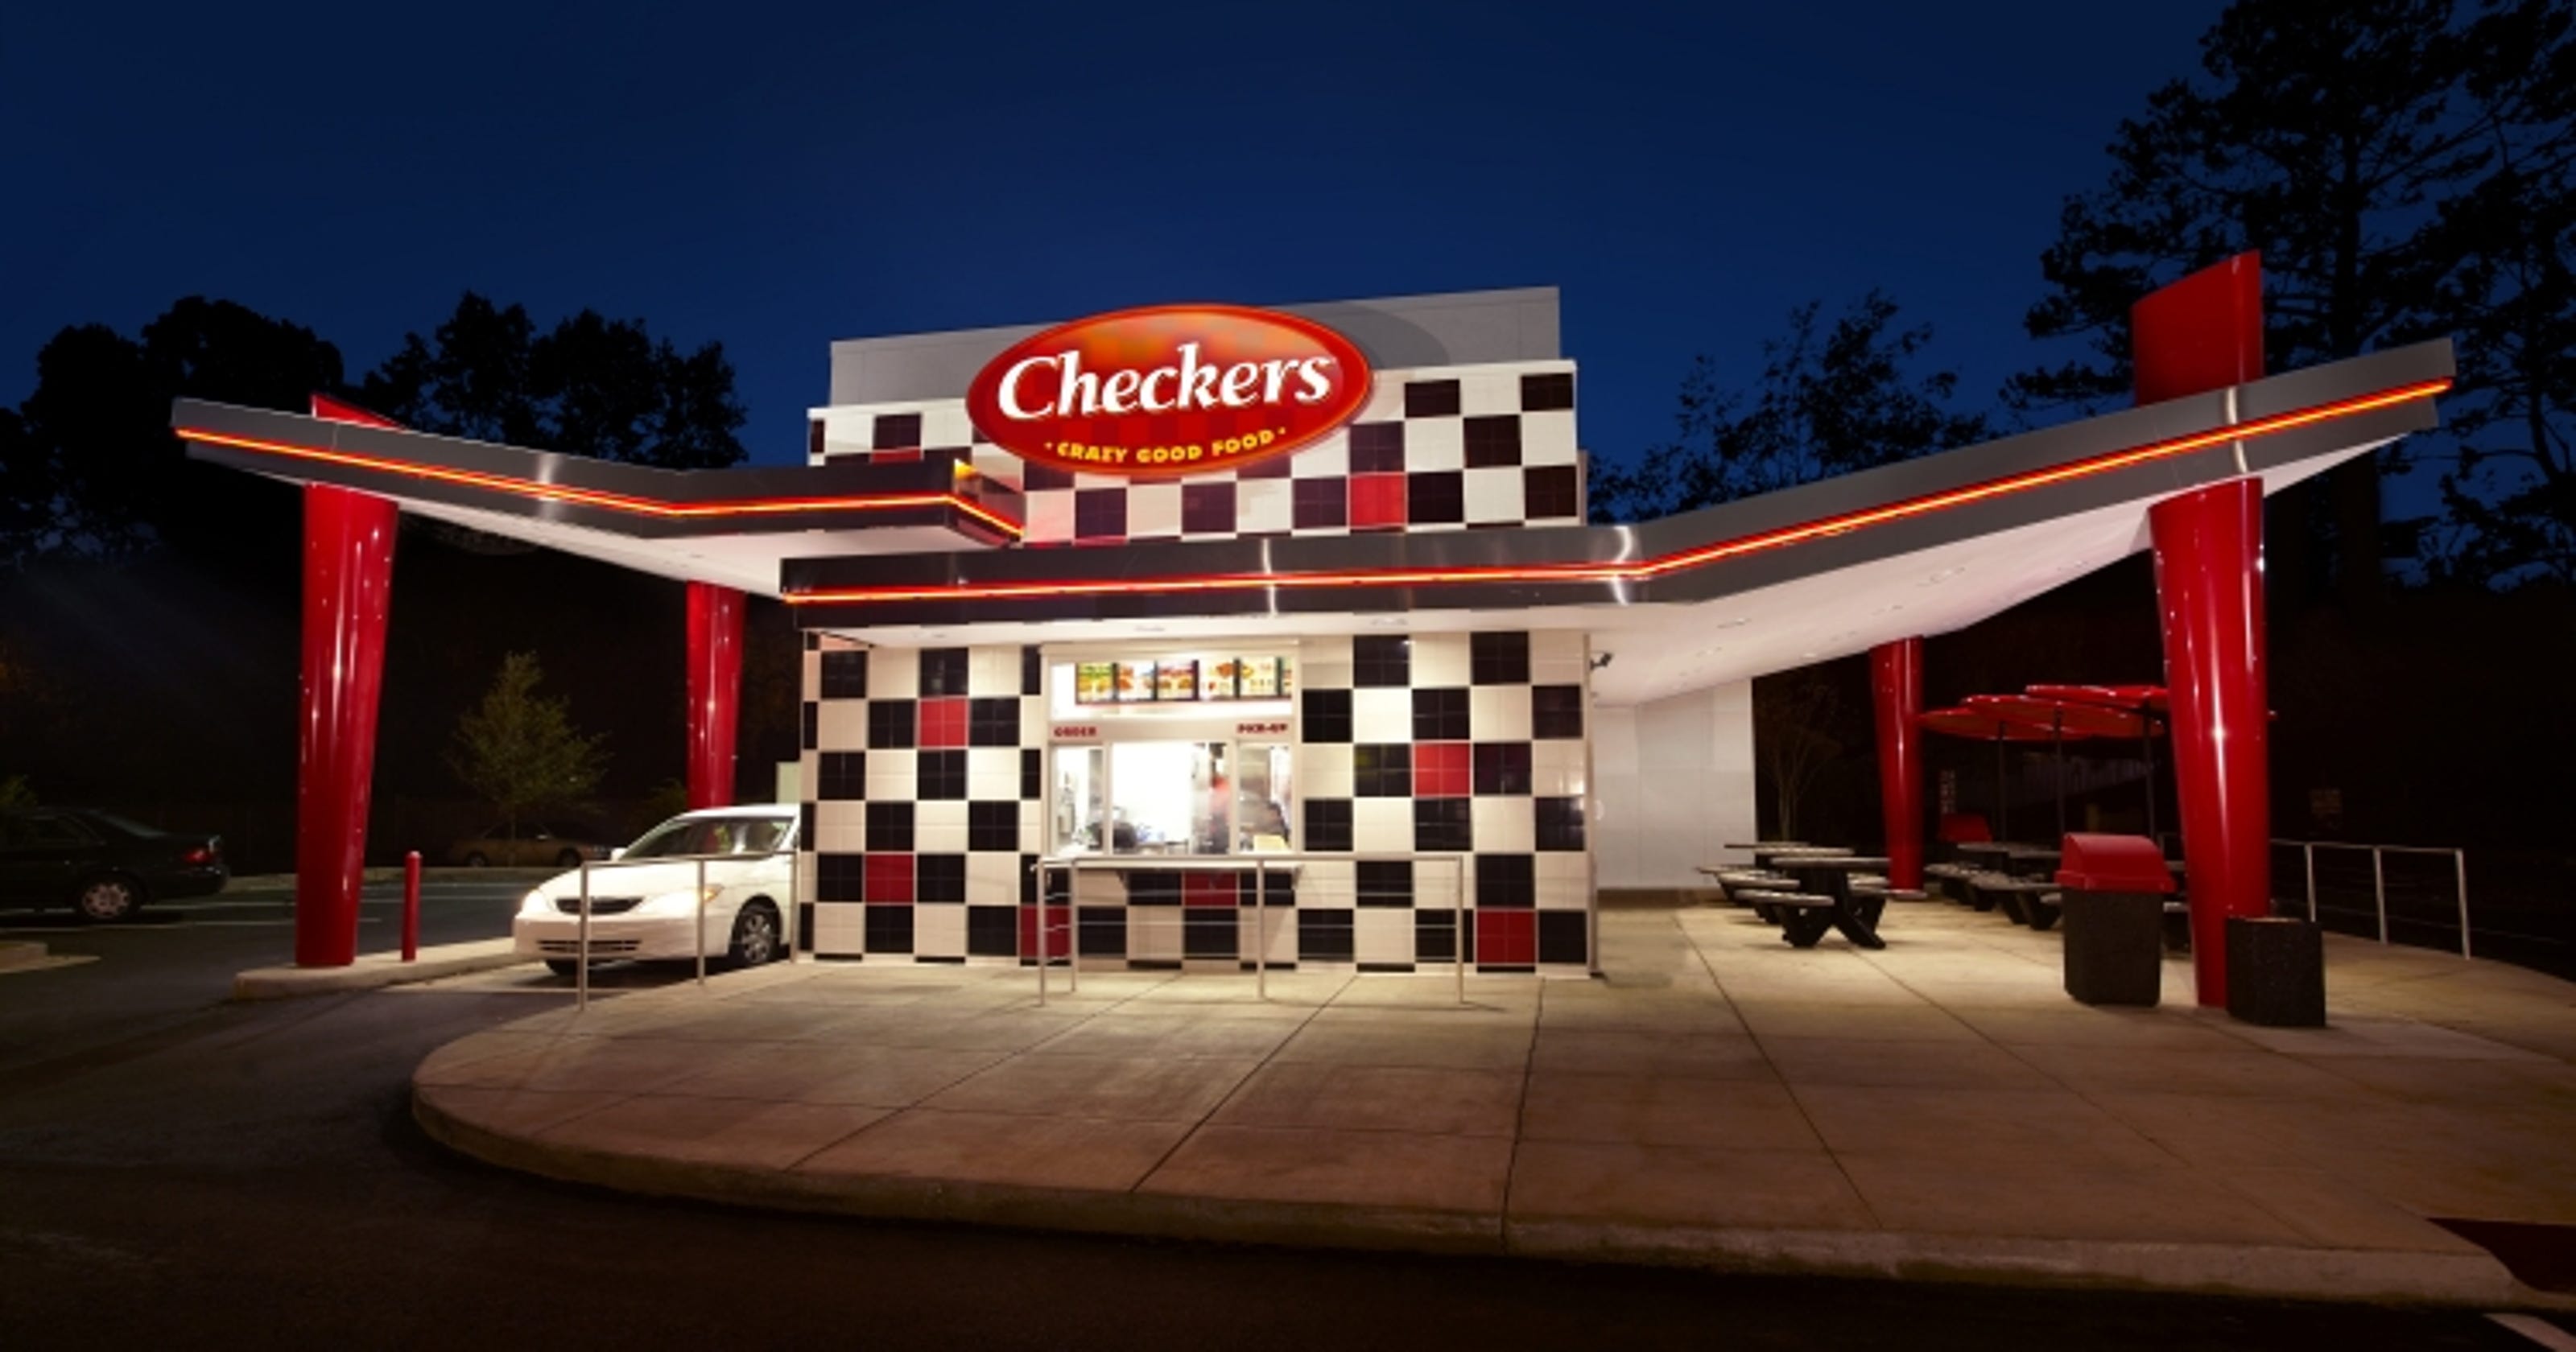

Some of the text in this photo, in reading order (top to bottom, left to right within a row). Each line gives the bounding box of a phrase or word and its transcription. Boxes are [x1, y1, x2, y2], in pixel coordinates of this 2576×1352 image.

[997, 341, 1333, 420] Checkers
[1056, 429, 1275, 464] CRAZY GOOD FOOD
